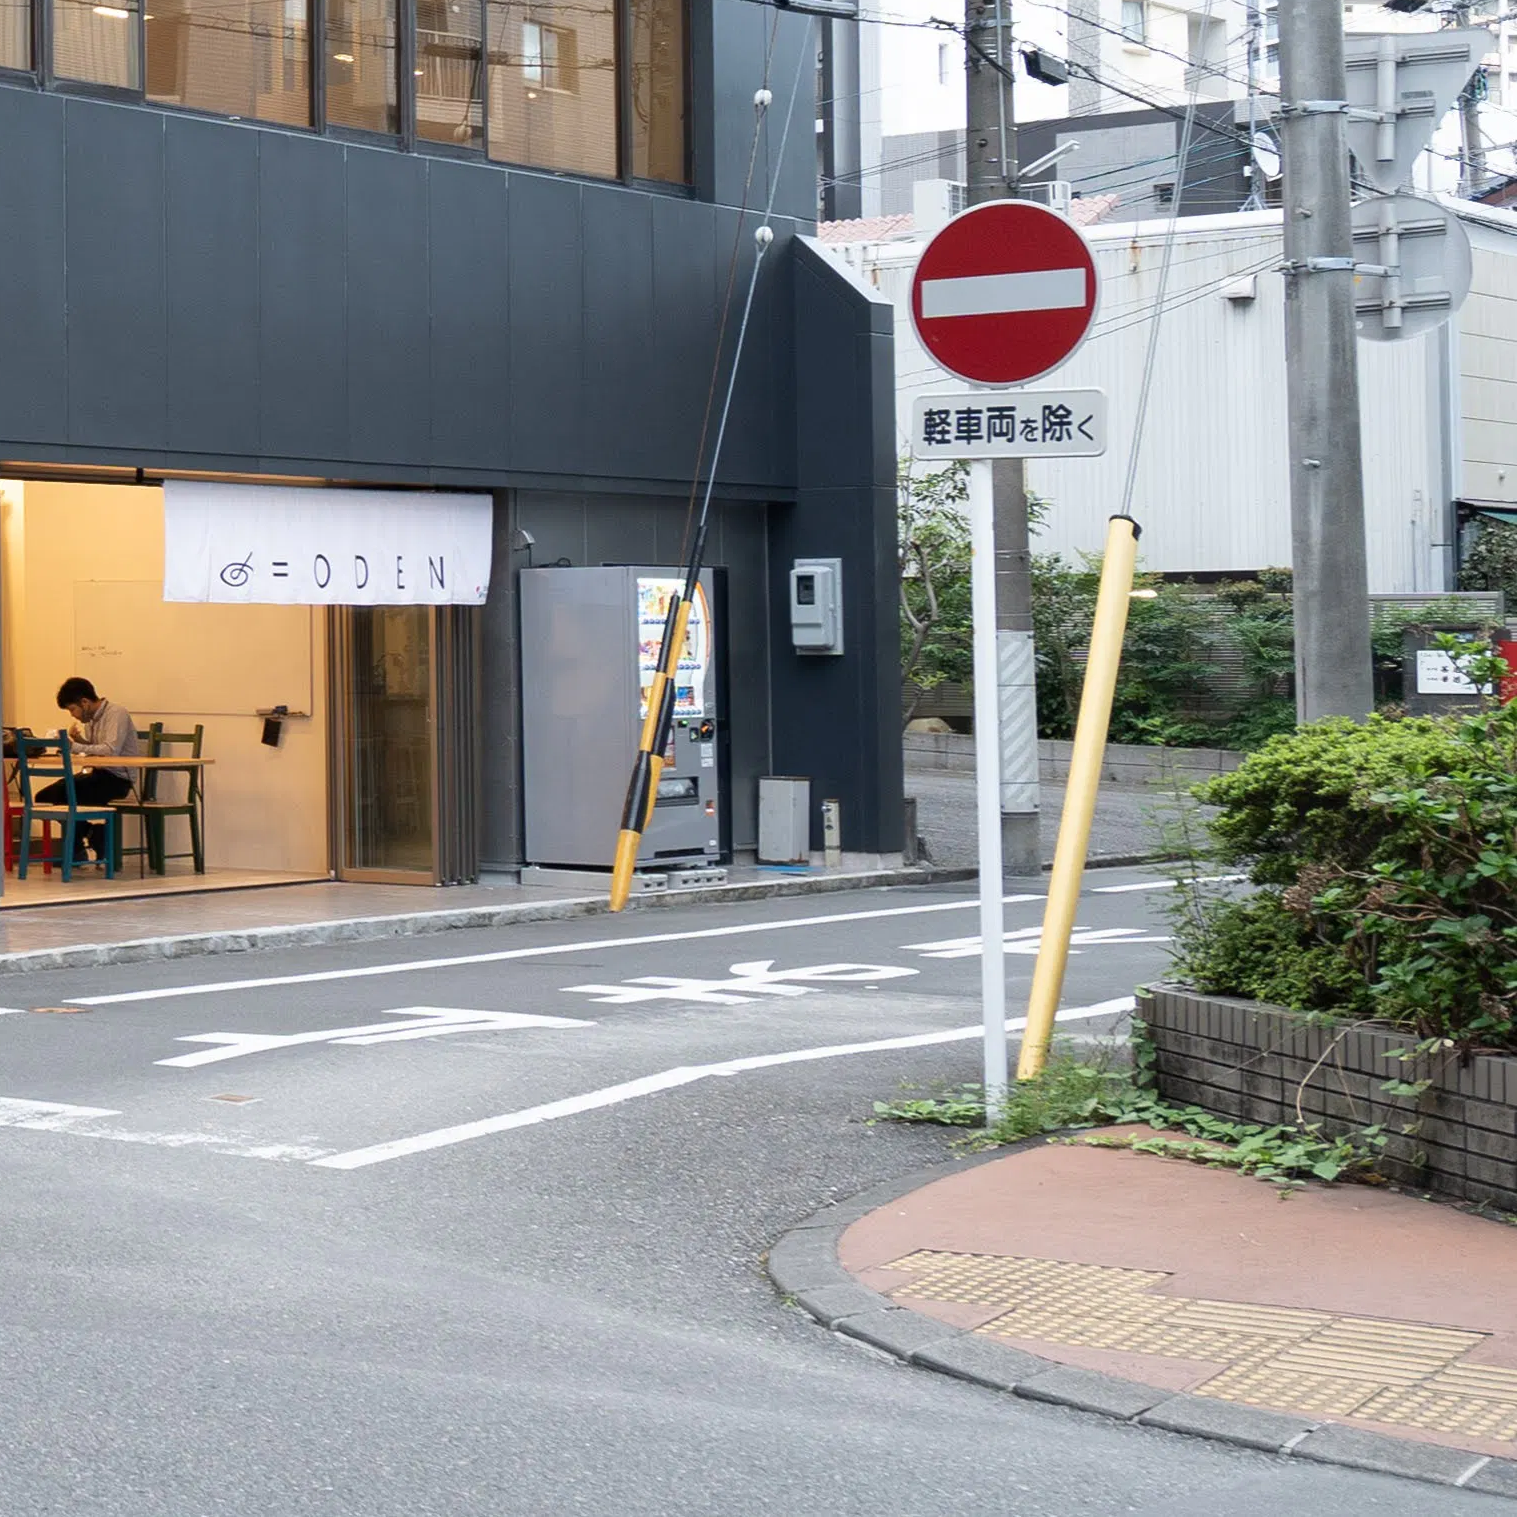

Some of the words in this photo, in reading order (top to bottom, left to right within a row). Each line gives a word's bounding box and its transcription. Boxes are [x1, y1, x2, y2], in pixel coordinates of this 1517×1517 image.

[922, 402, 1095, 447] 軽車両を除く
